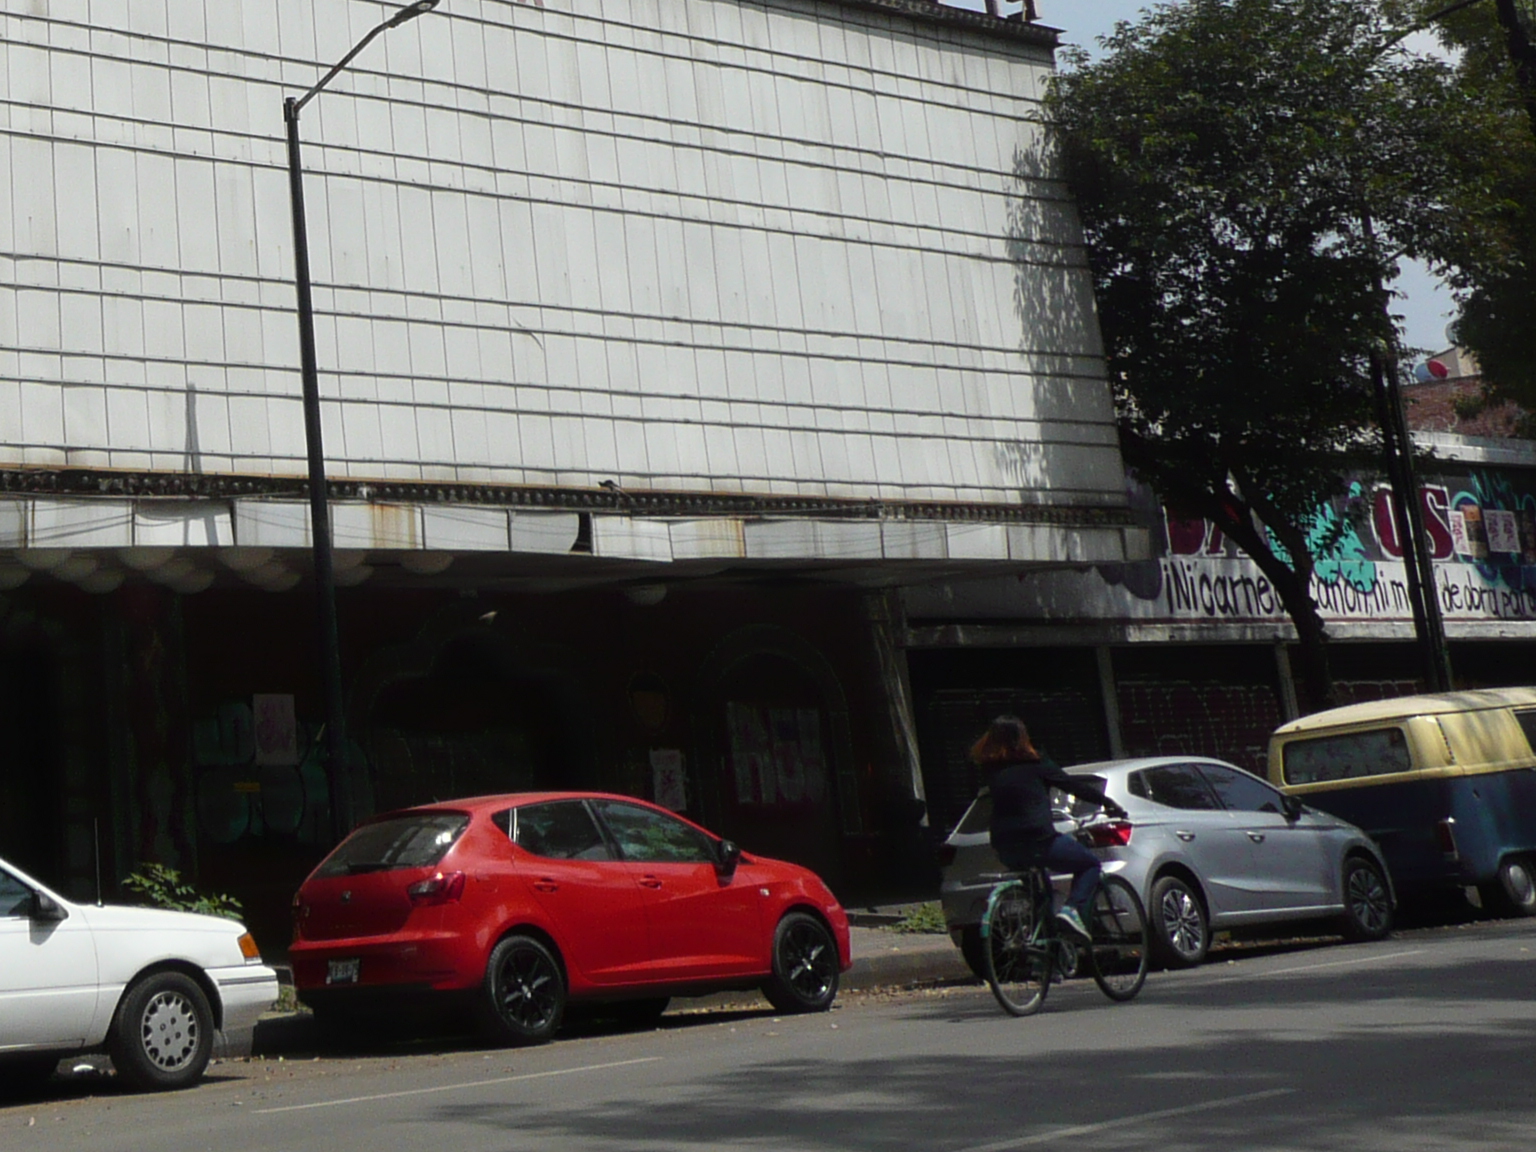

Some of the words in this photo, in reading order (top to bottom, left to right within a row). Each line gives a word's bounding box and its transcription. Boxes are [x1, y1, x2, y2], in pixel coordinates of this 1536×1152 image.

[1199, 572, 1274, 616] carne
[1442, 568, 1463, 613] de
[1464, 570, 1502, 618] obra
